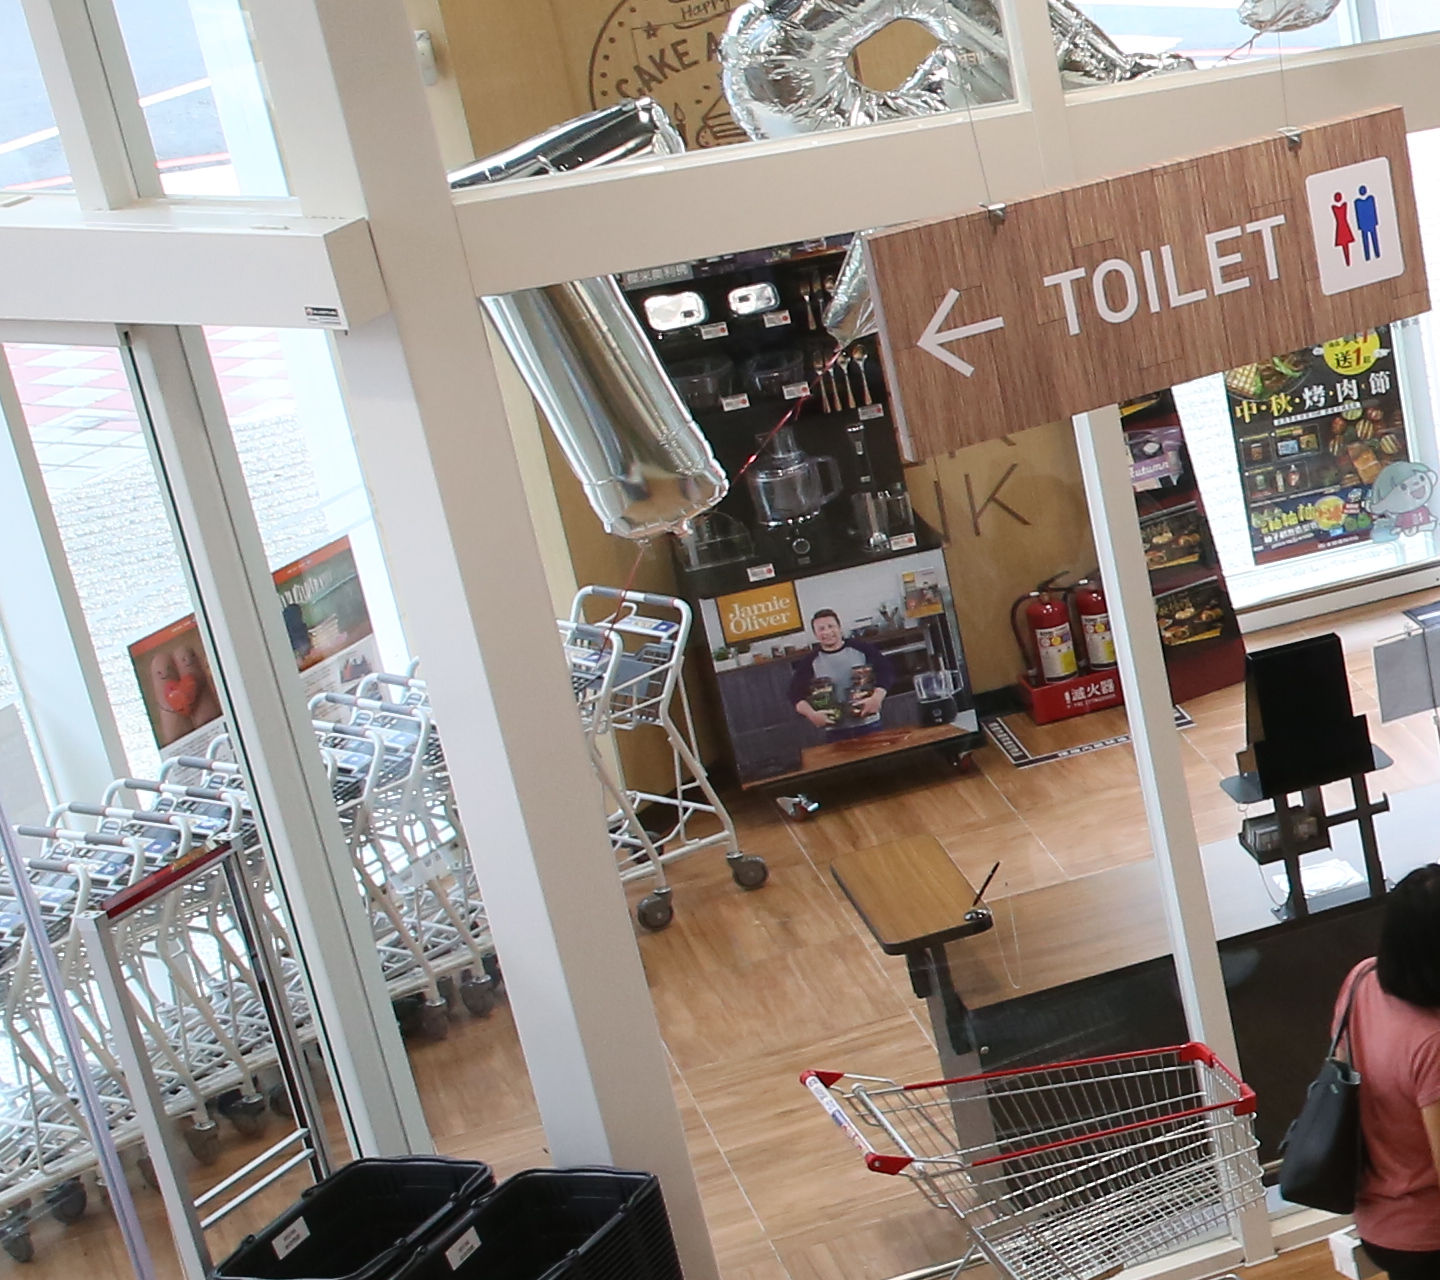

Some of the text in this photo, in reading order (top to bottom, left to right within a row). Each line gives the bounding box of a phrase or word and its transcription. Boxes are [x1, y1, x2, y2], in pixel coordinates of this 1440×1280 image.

[614, 30, 699, 100] CAKE
[1043, 213, 1285, 338] TOILET
[729, 595, 791, 621] Jamie
[730, 611, 791, 635] Oliver
